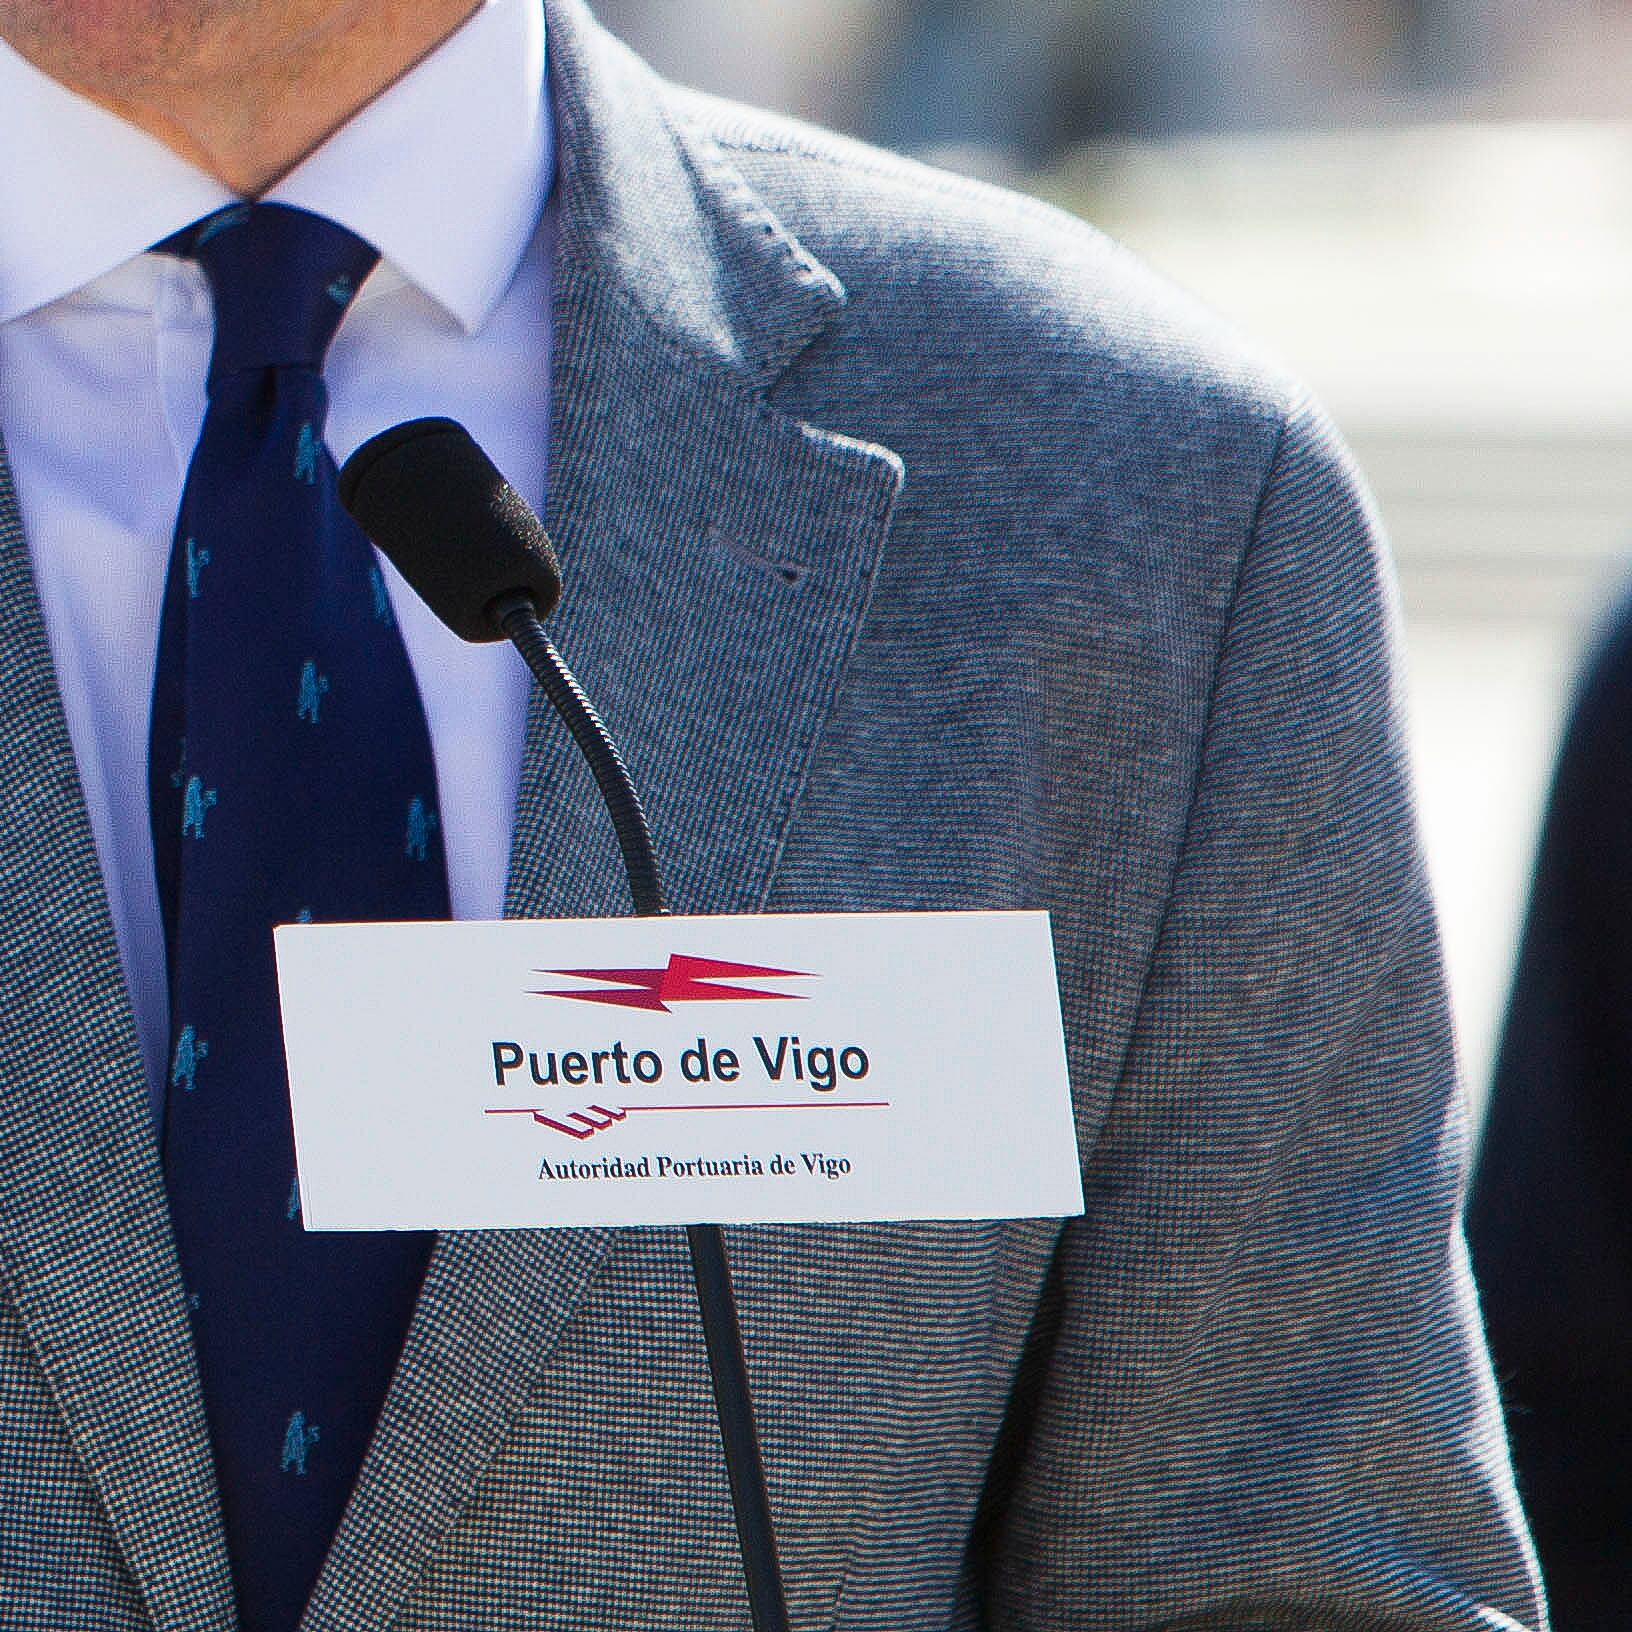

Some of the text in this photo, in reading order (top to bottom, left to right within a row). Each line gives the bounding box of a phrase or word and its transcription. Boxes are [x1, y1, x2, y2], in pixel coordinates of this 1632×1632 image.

[491, 1036, 870, 1092] Puerto de Vigo
[538, 1152, 851, 1180] Autoridad Portuaria de Vigo
